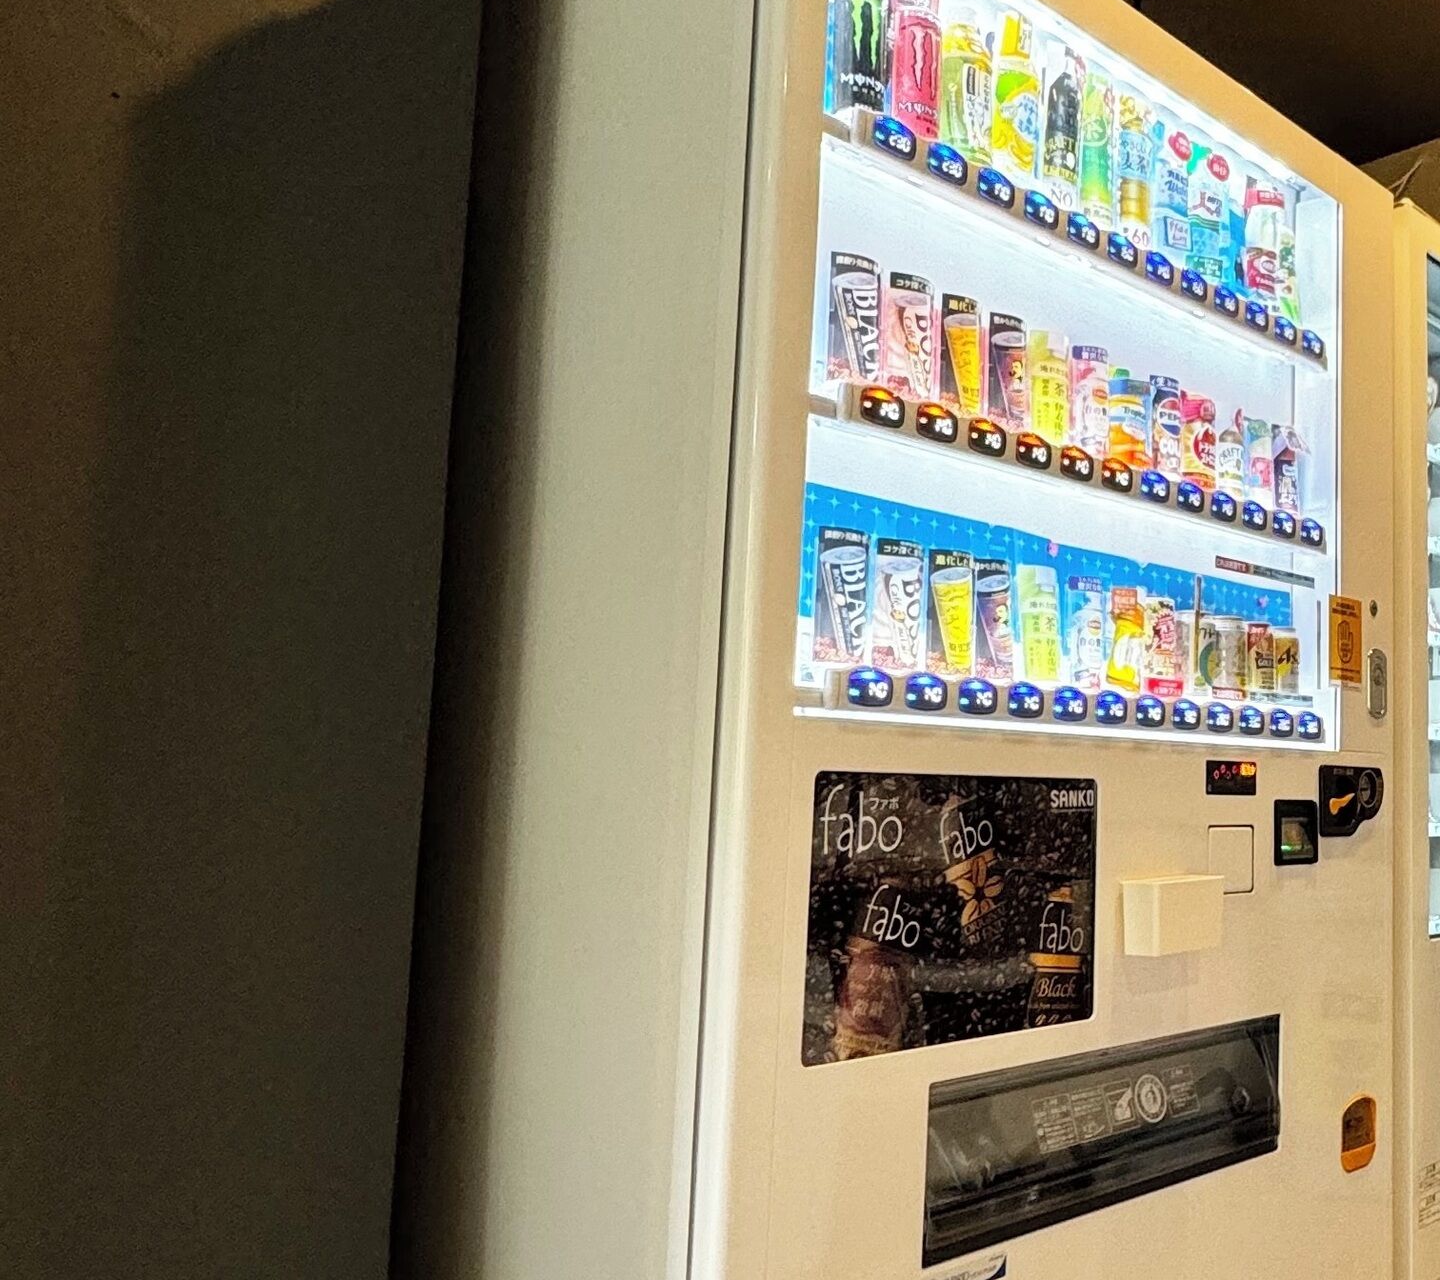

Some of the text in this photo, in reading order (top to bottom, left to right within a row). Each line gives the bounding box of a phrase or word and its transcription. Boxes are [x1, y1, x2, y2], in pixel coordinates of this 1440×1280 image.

[819, 783, 903, 858] fabo
[868, 796, 900, 810] ファボ
[1050, 789, 1095, 808] SANKO
[938, 812, 993, 865] fabo
[862, 884, 921, 948] fabo
[1039, 902, 1085, 954] fabo
